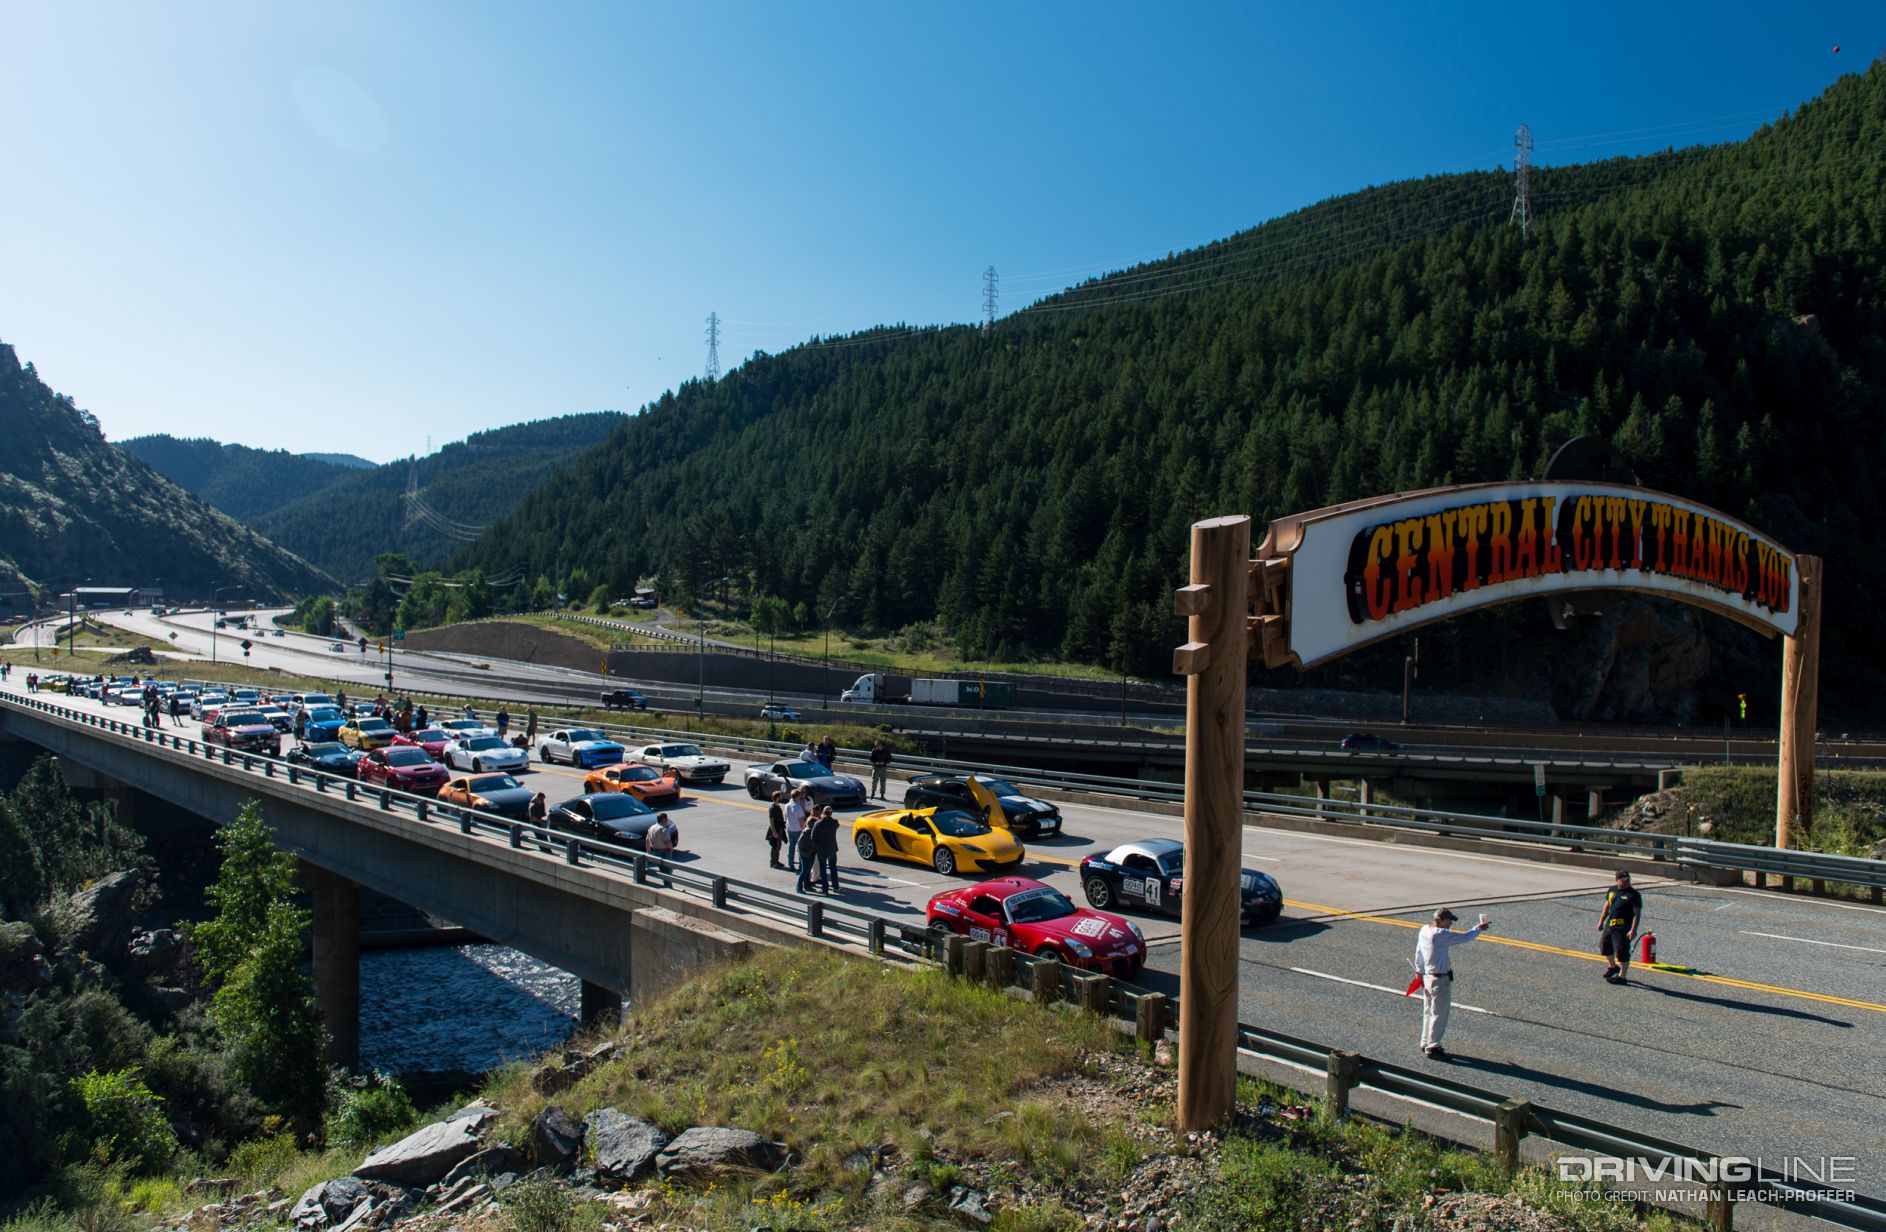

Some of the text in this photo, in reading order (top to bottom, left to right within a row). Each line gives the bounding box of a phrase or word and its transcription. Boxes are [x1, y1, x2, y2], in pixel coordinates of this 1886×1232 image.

[1363, 495, 1793, 621] CENTRAL CITY THANKS YOU
[1146, 884, 1158, 899] 41
